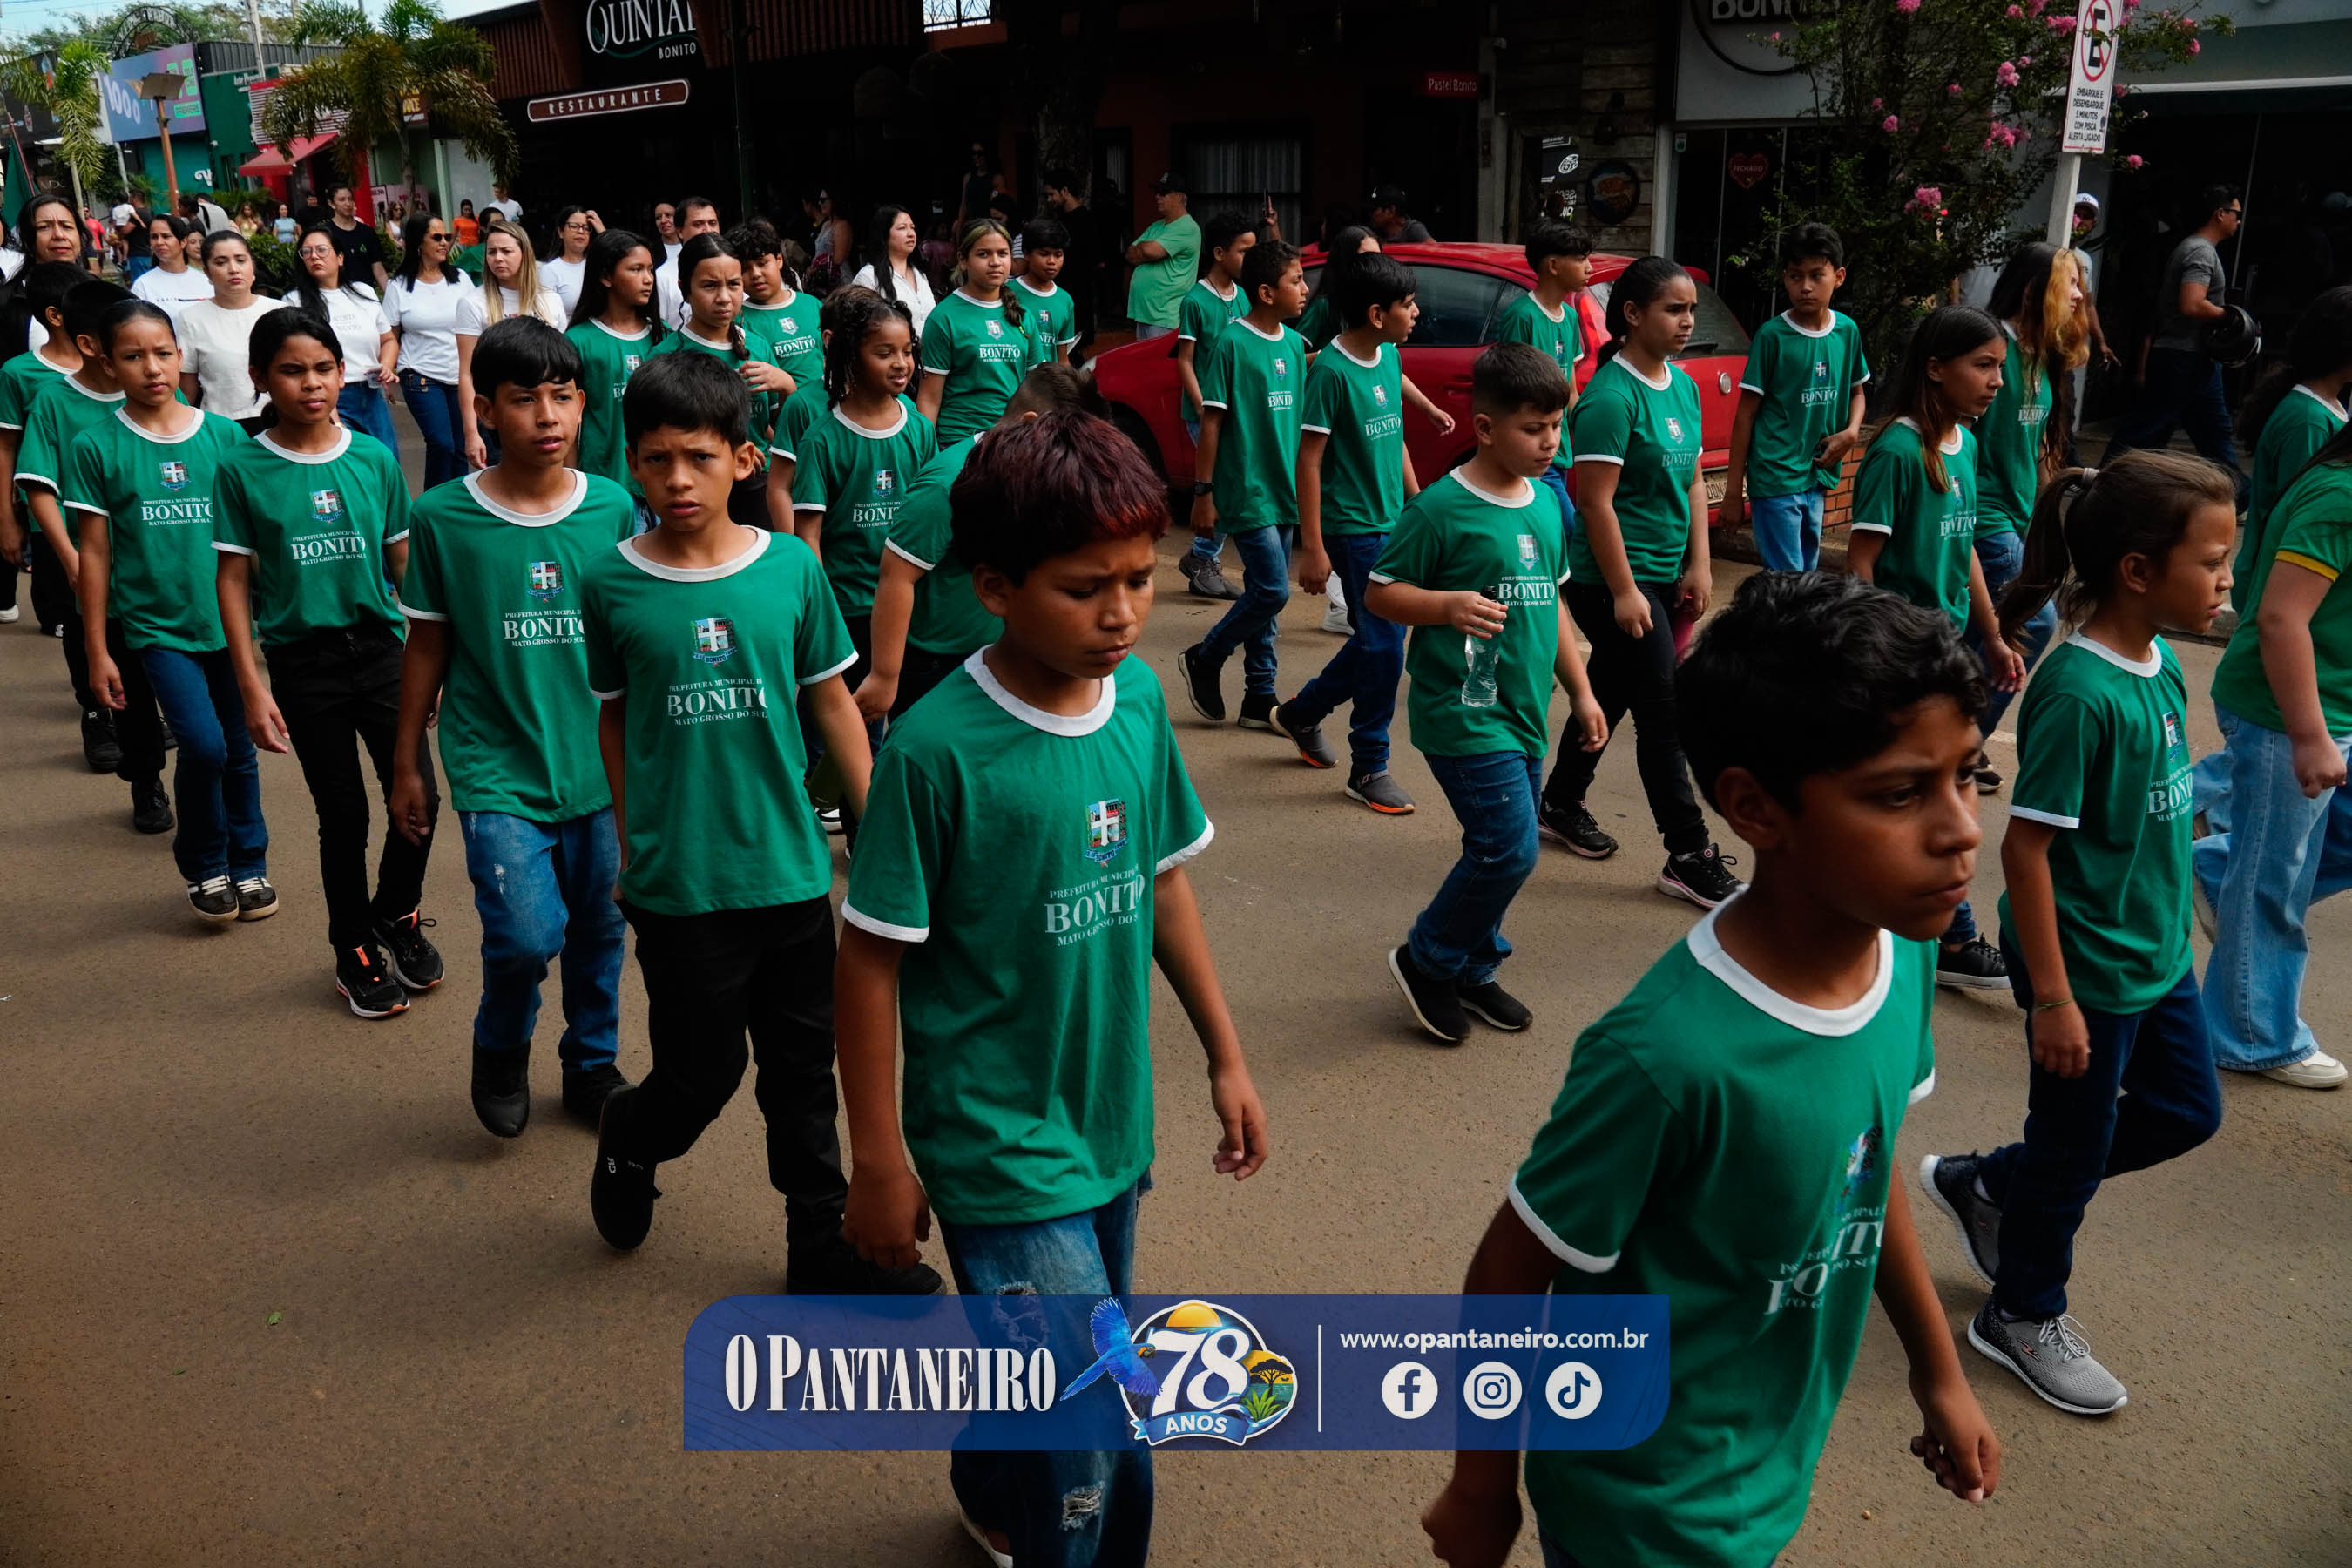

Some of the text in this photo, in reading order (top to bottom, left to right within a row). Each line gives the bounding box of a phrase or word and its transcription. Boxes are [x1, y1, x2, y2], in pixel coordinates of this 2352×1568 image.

[659, 42, 696, 59] BONITO
[1429, 78, 1477, 91] Pastel Bonito
[2077, 87, 2100, 98] EMBARQUE
[548, 88, 662, 115] RESTAURANTE
[2072, 98, 2104, 110] DESEMBARQUE
[2079, 111, 2099, 120] MINUTOS
[2074, 120, 2097, 131] COM PISCA
[2084, 133, 2101, 143] LIGADO
[774, 338, 815, 355] BONITO
[978, 348, 1020, 358] BONITO
[1801, 390, 1837, 403] BONIO
[1365, 416, 1402, 436] BONITO
[1498, 582, 1555, 600] BONITO
[699, 713, 734, 722] GROSSO
[736, 710, 750, 719] DO
[1044, 874, 1146, 934] BONITO
[1058, 931, 1085, 947] MATO
[1118, 914, 1132, 925] DO
